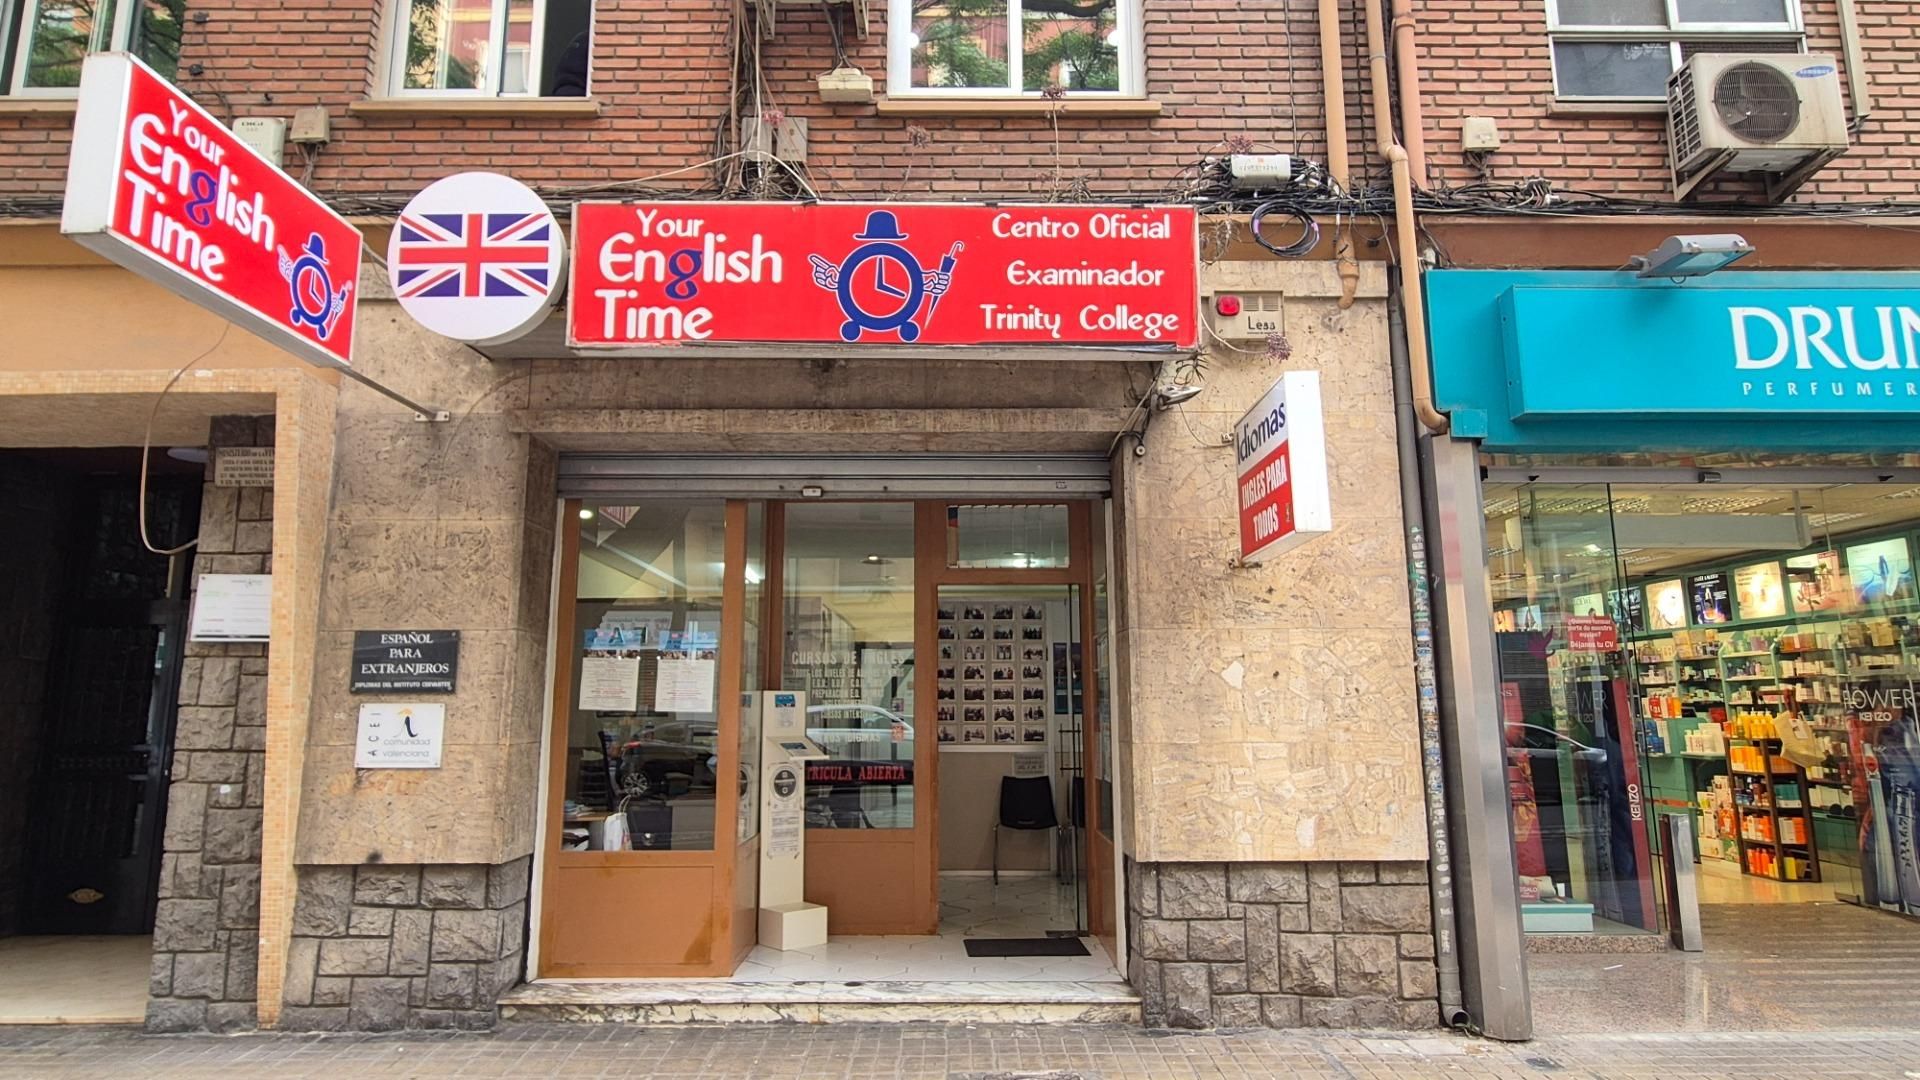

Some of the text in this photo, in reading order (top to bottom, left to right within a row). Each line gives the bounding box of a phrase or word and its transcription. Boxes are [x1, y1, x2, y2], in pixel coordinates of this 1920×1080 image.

[169, 98, 225, 166] Your
[130, 112, 275, 251] English
[124, 169, 225, 281] Time
[636, 208, 704, 238] Your
[992, 212, 1171, 239] Centro Oficial
[599, 231, 783, 300] English
[1006, 259, 1165, 286] Examinador
[594, 288, 714, 339] Time
[979, 303, 1180, 339] Trinity College
[1742, 381, 1919, 396] PERFUMER
[1236, 402, 1286, 464] Idiomas
[1241, 454, 1288, 511] INGLES PARA
[1253, 502, 1279, 542] TODOS
[380, 632, 434, 644] ESPAÑOL
[389, 648, 423, 659] PARA
[792, 651, 837, 665] CURSOS
[844, 651, 857, 665] DE
[361, 663, 450, 676] EXTRANJEROS
[1859, 711, 1893, 722] KENZO
[383, 738, 431, 746] comunidad
[858, 766, 905, 780] ABIERTA
[1628, 783, 1643, 821] KENZO
